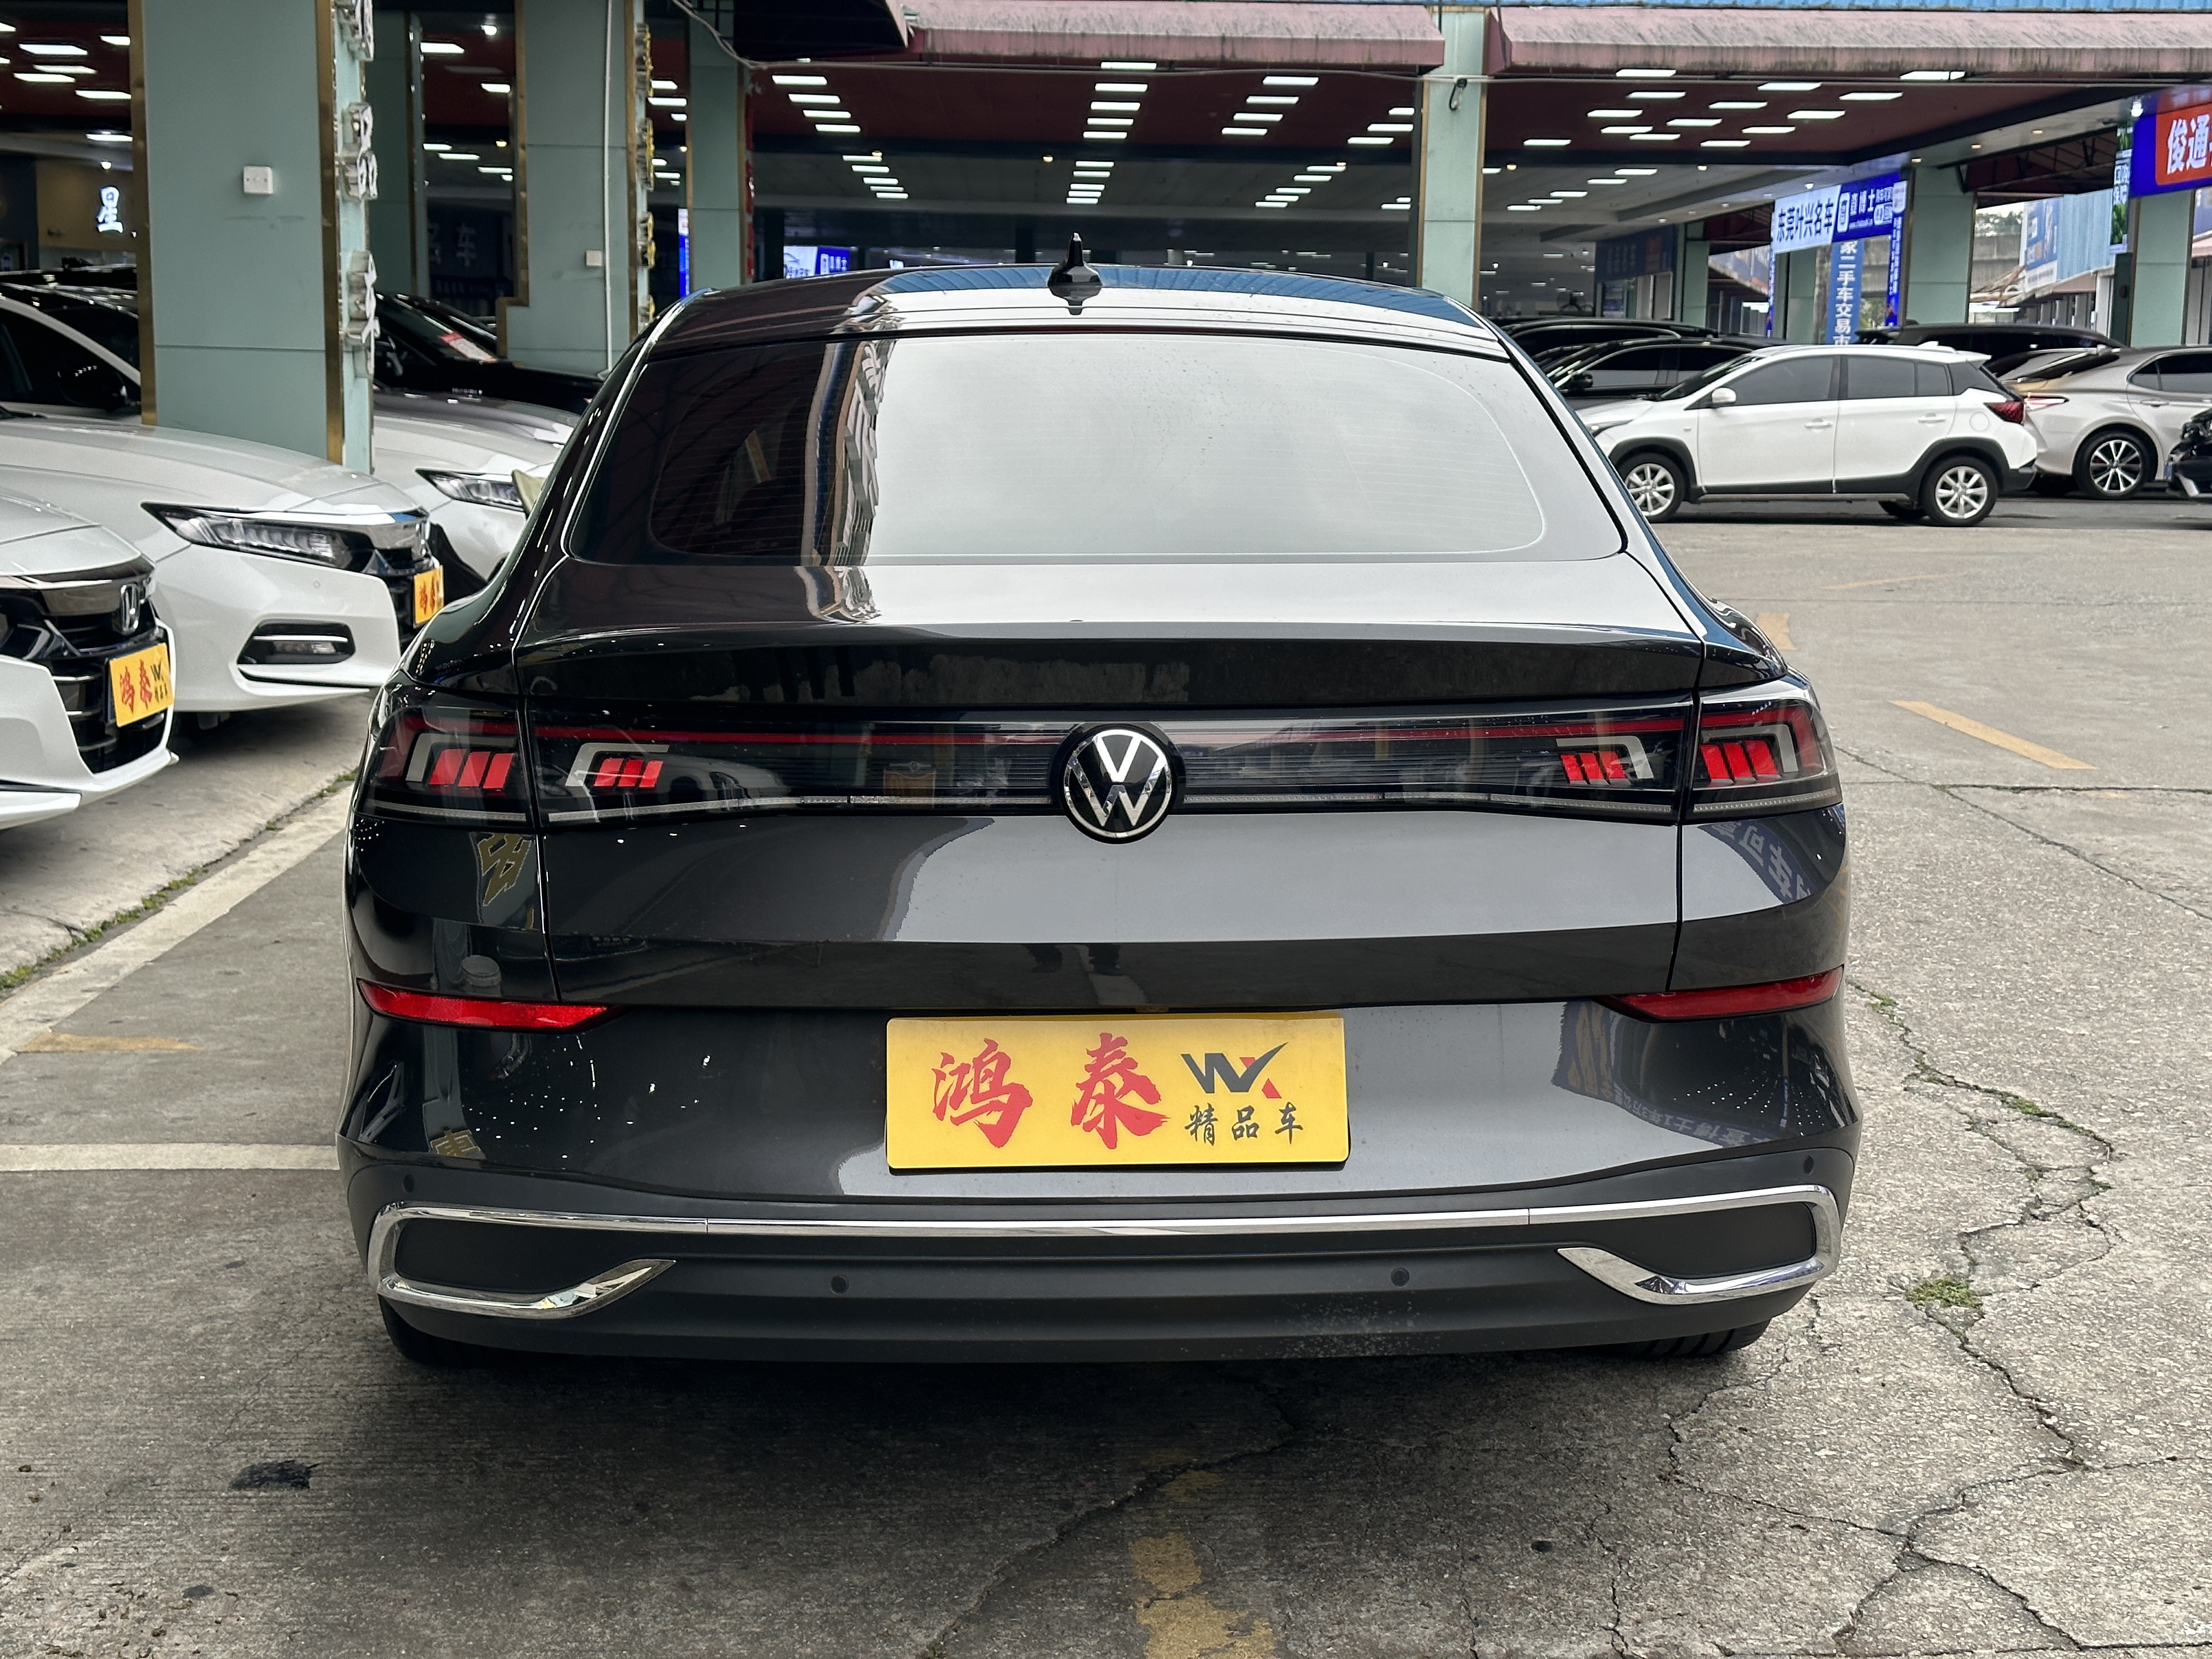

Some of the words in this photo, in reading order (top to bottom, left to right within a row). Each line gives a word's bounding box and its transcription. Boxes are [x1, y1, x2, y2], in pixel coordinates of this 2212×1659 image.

[2167, 114, 2212, 174] 俊通
[932, 1032, 1171, 1150] 鸿泰
[1184, 1102, 1304, 1146] 精品车
